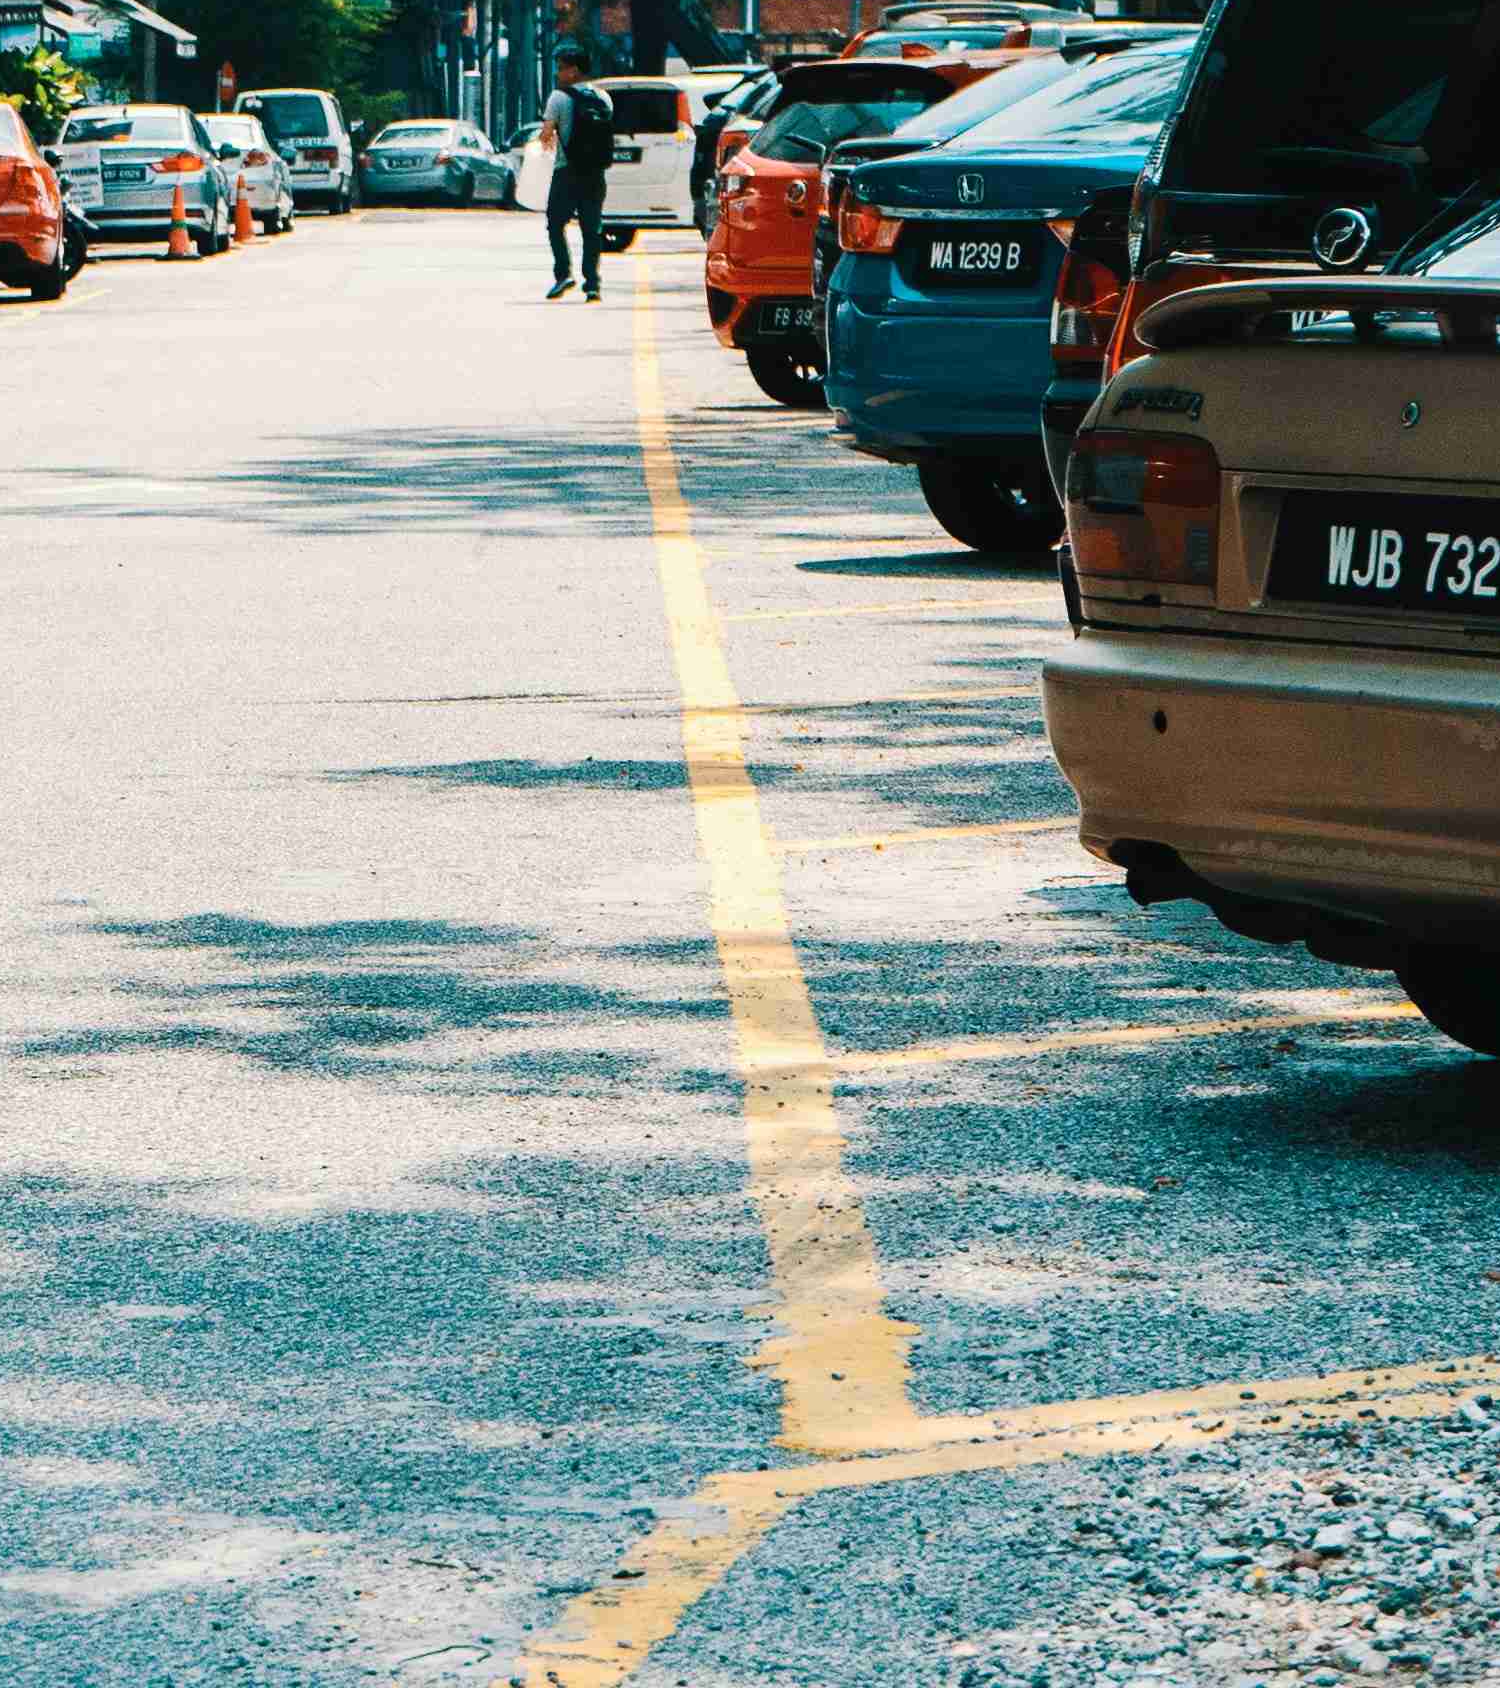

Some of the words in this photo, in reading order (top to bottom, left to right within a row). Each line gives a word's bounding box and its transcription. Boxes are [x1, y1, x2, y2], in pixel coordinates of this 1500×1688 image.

[930, 243, 953, 270] WA
[959, 243, 1002, 270] 1239
[1006, 243, 1021, 271] B
[1328, 527, 1404, 590] WJB
